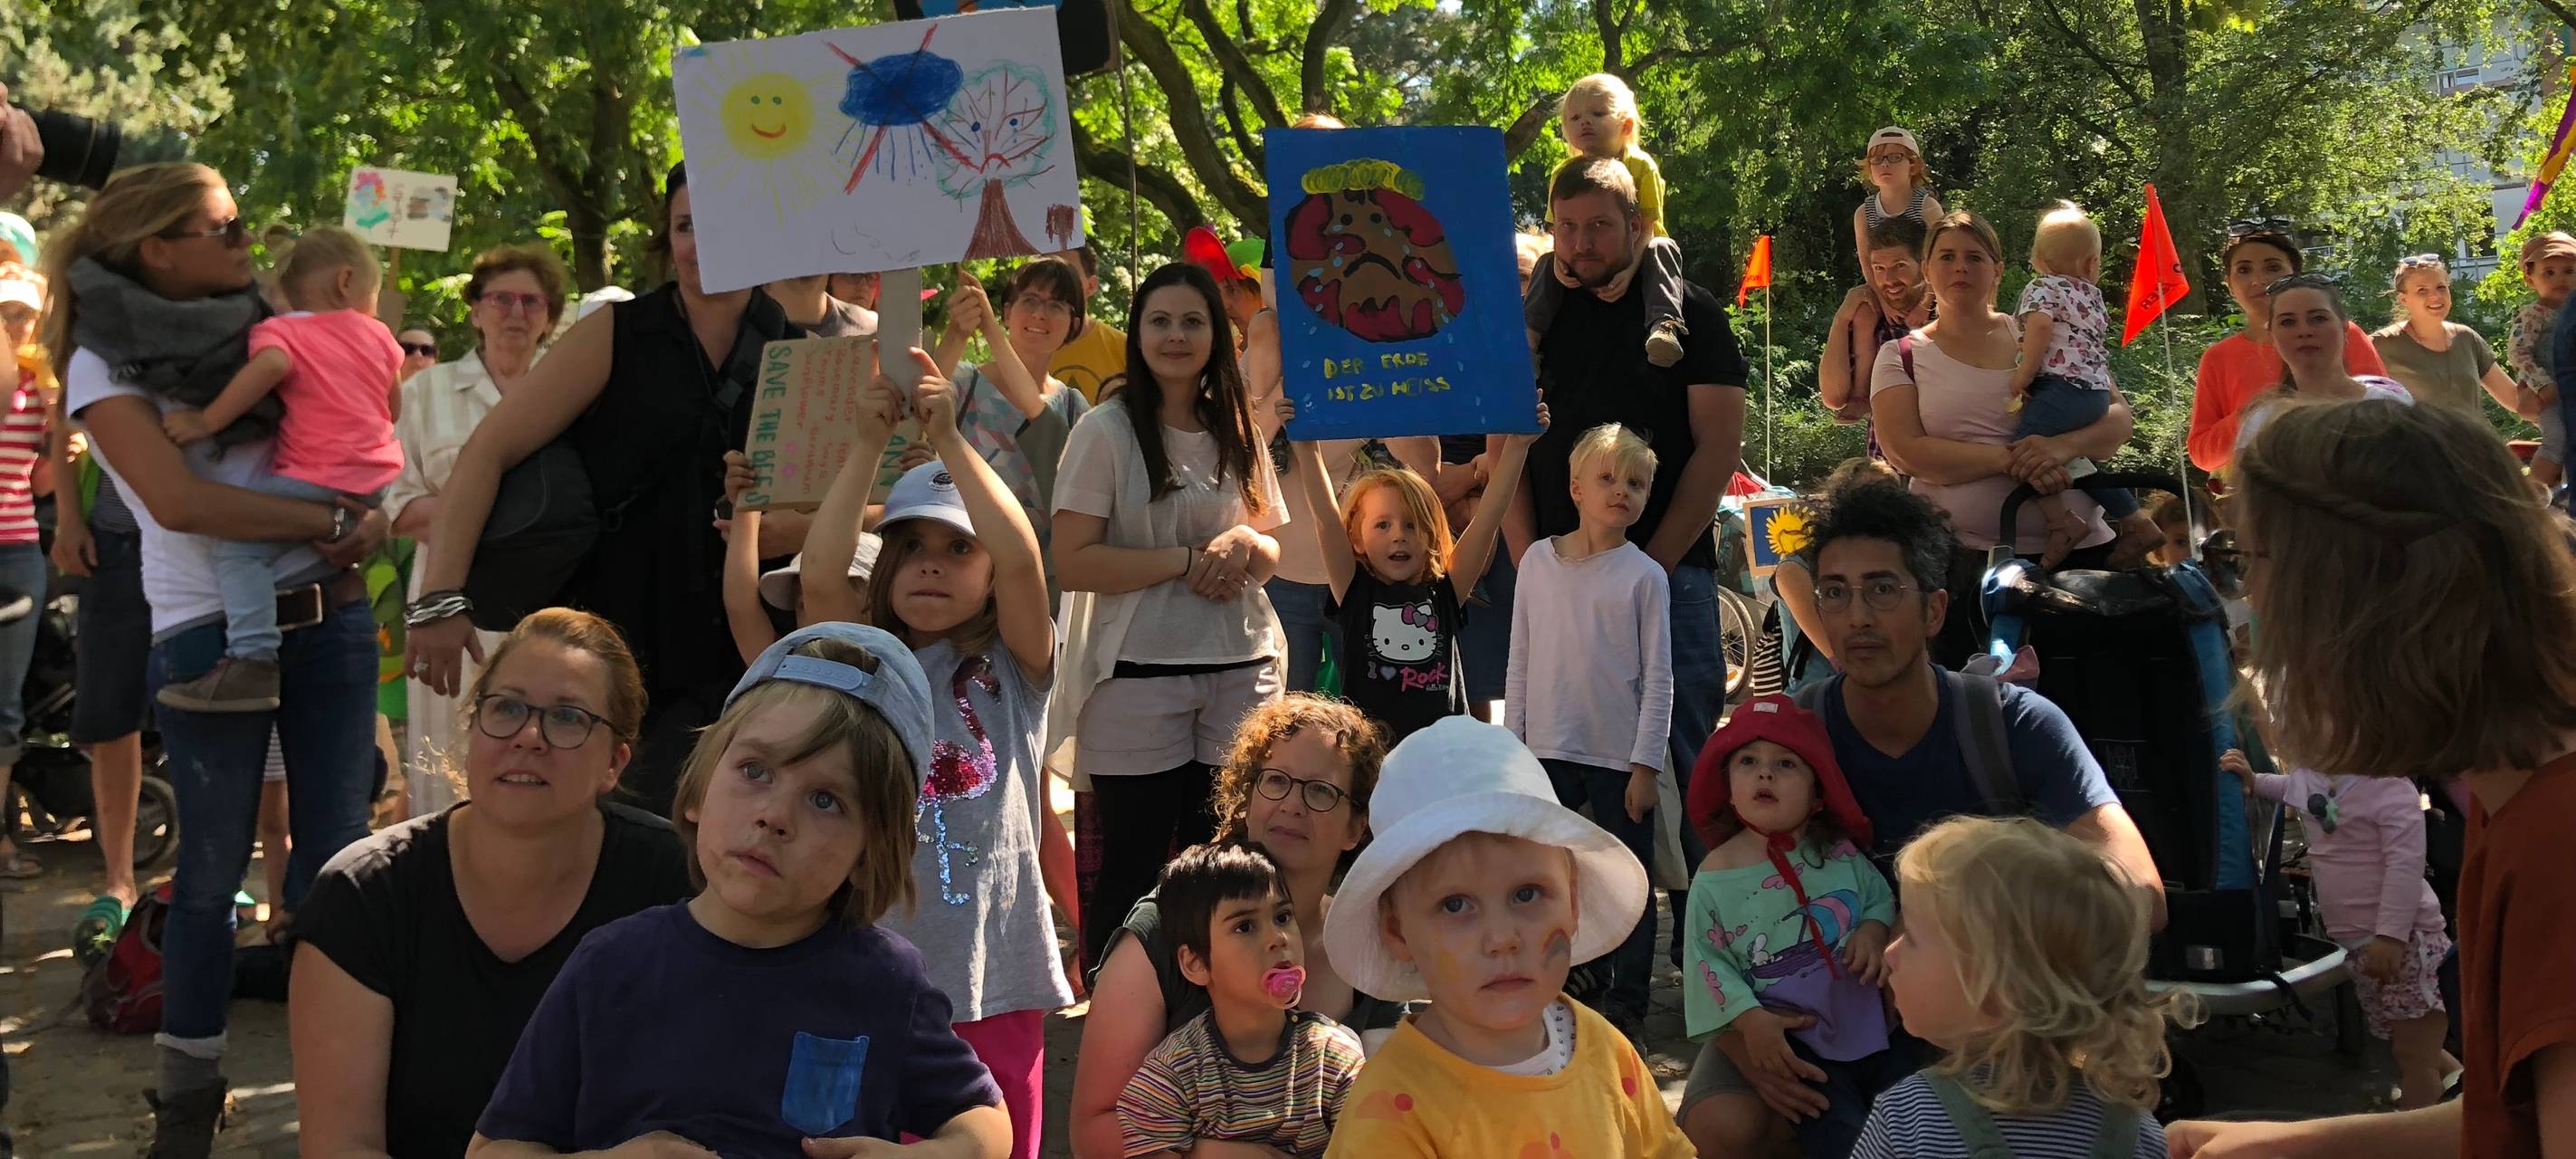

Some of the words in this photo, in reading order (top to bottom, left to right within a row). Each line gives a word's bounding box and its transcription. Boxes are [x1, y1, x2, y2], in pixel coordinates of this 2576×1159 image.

[763, 346, 792, 399] SAVE
[1324, 358, 1363, 378] DER
[1328, 385, 1354, 401] IST
[1360, 382, 1384, 400] ZU
[1391, 376, 1450, 397] HEISS
[756, 408, 781, 443] THE
[1368, 661, 1378, 679] I
[1399, 662, 1449, 692] Rock
